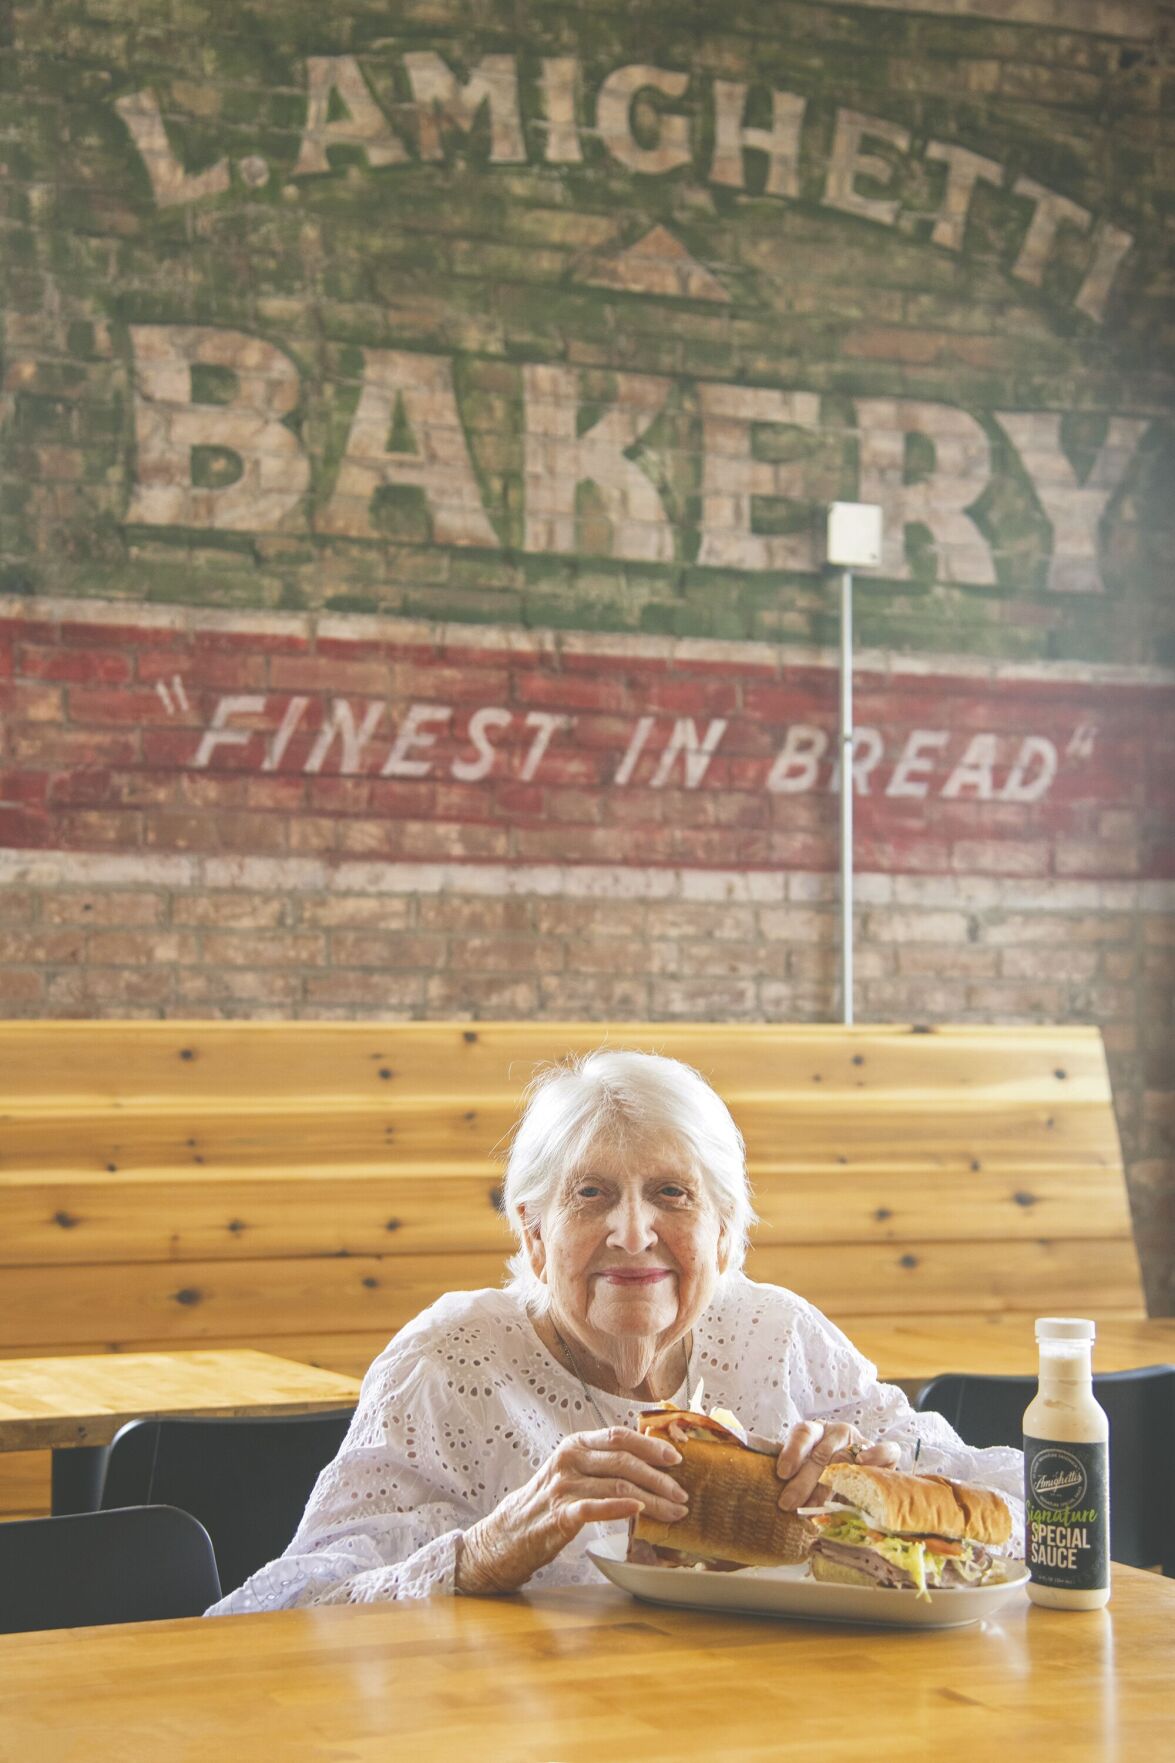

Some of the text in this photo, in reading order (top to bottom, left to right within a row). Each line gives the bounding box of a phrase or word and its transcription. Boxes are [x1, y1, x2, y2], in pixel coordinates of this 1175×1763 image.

[293, 50, 1133, 324] AMIGHETTI
[122, 324, 1150, 592] BAKERY
[613, 716, 728, 789] IN
[1025, 1499, 1097, 1527] Signature
[1031, 1522, 1091, 1549] SPECIAL
[1031, 1542, 1078, 1569] SAUCE
